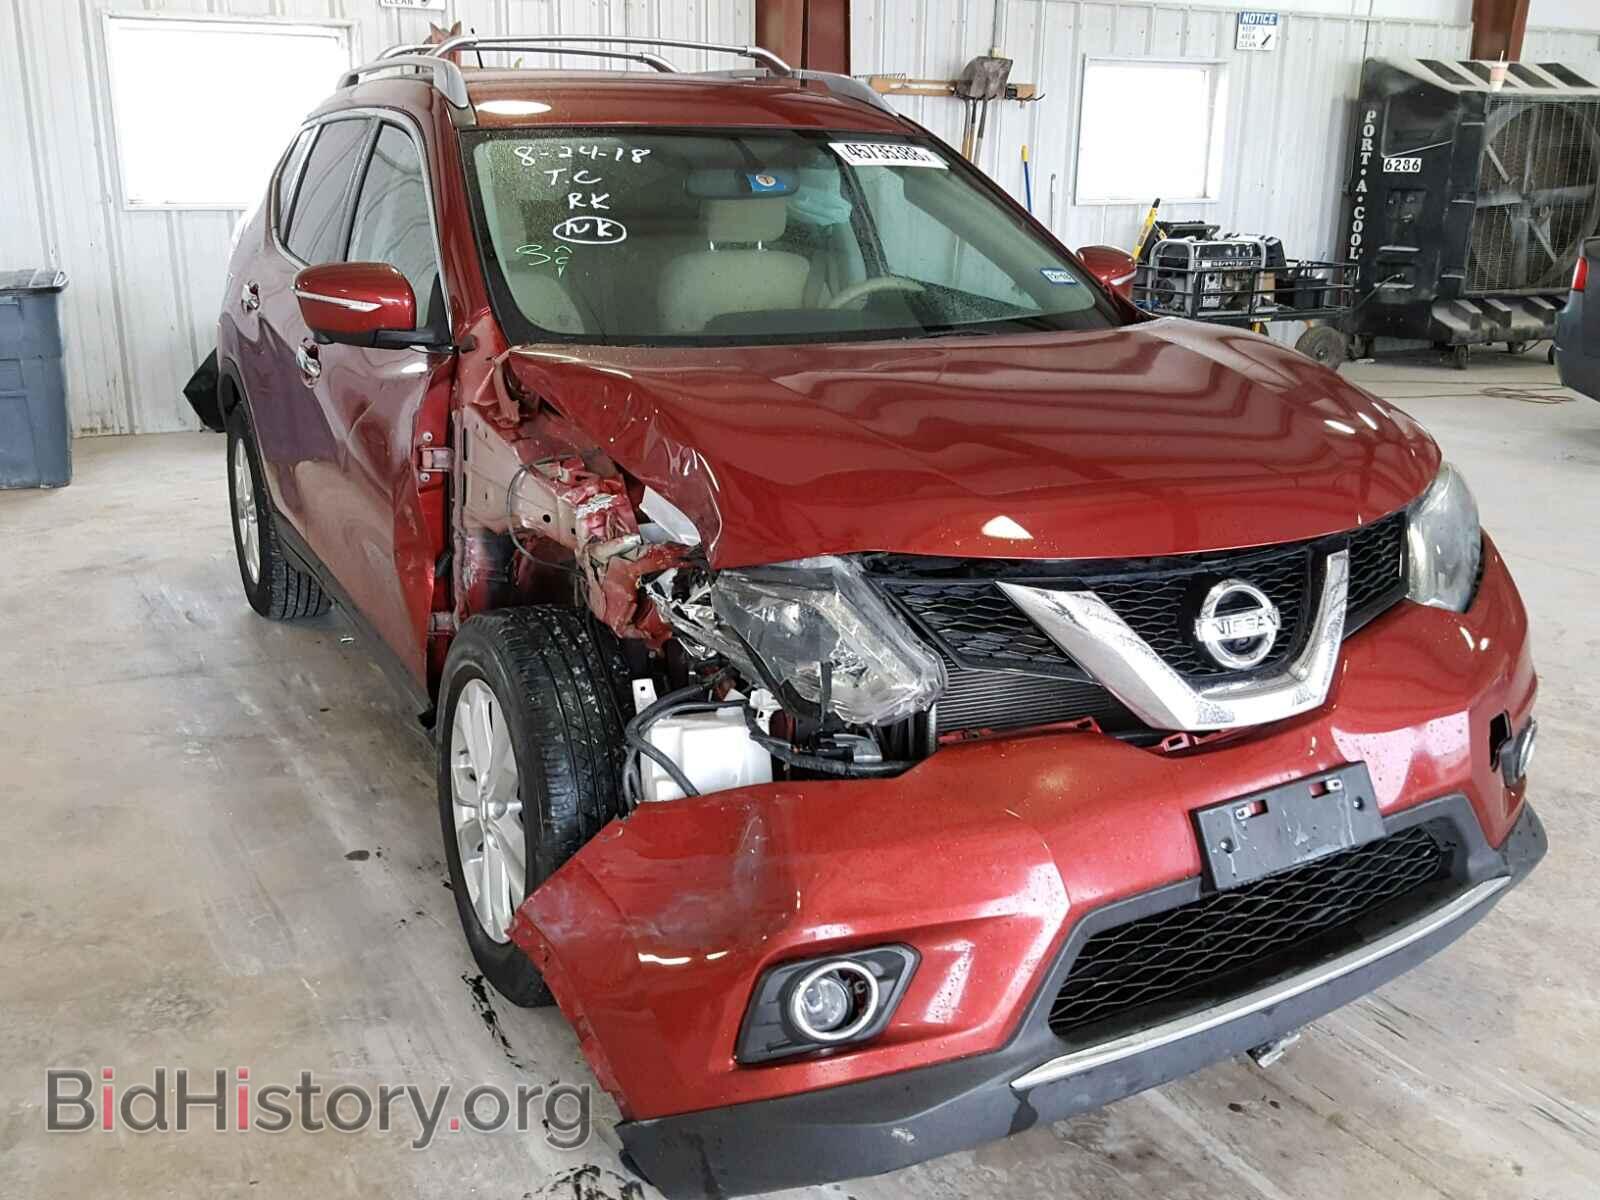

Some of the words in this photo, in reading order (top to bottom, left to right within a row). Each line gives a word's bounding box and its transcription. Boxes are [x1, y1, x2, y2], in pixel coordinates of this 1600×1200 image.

[1241, 13, 1276, 24] NOTICE
[514, 145, 651, 166] 8-24-18
[1385, 159, 1420, 171] 6286
[567, 192, 611, 210] RK
